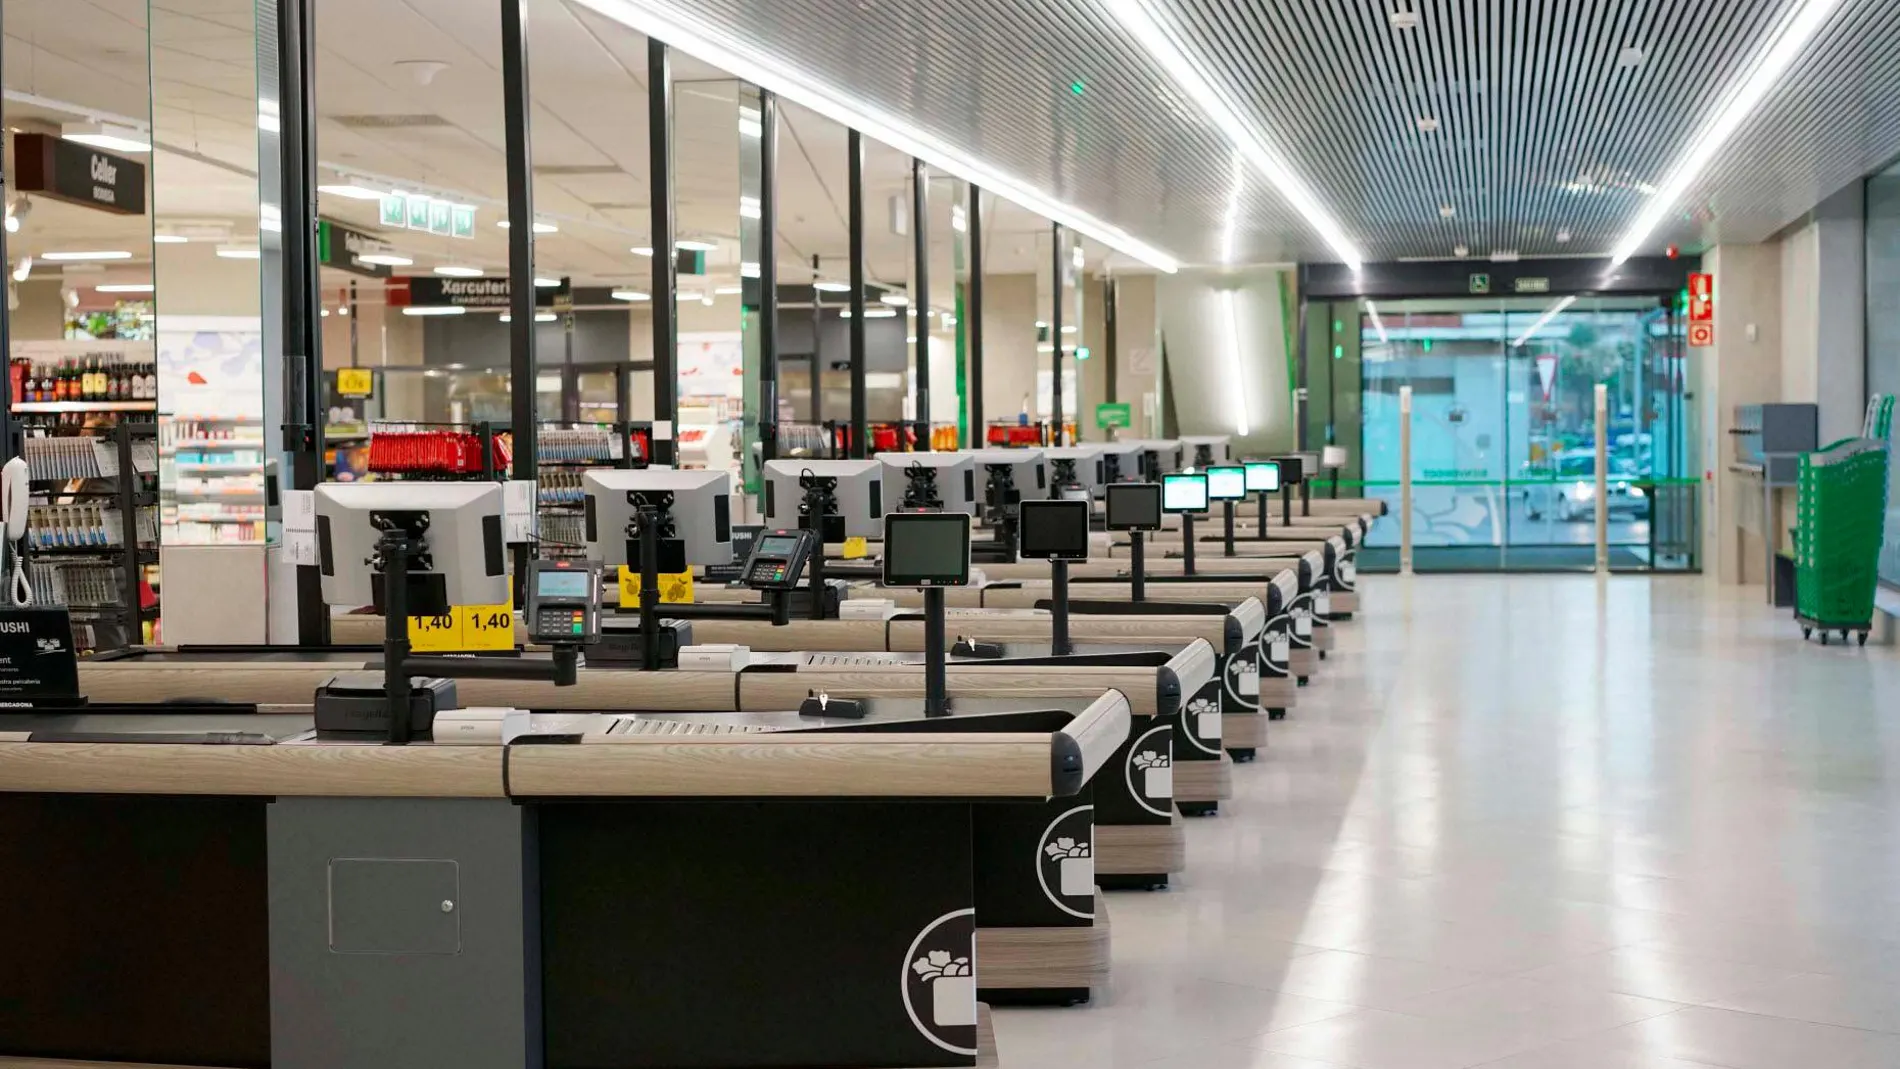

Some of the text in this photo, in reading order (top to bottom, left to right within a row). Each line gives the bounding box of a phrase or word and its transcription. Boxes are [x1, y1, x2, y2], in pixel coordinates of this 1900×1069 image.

[91, 154, 117, 185] Celler
[441, 279, 511, 294] Xarcuteri
[0, 621, 30, 633] USHI
[414, 613, 453, 632] 1,40
[472, 613, 510, 632] 1,40
